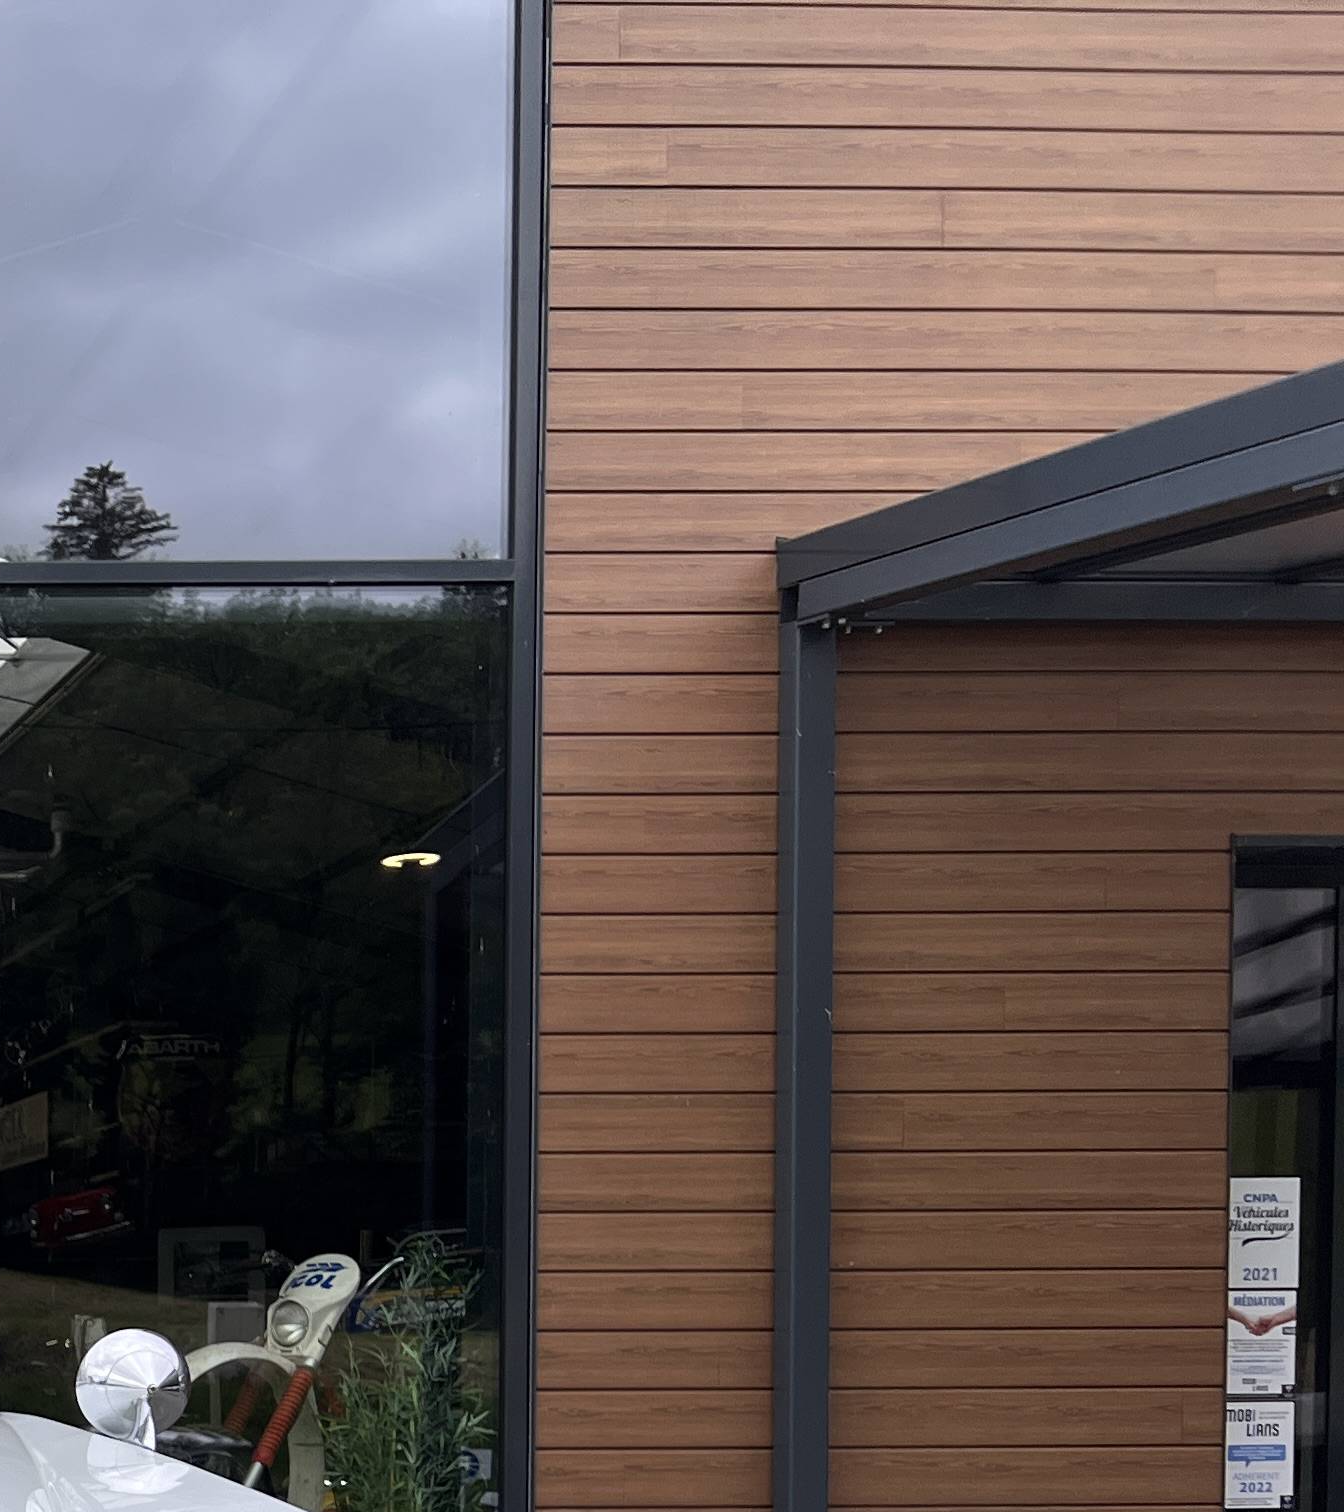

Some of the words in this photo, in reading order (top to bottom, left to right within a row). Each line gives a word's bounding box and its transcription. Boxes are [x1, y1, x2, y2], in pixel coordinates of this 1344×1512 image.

[127, 1039, 221, 1054] ABARTH
[1243, 1193, 1279, 1203] CNPA
[1228, 1219, 1295, 1235] Historiques
[1242, 1267, 1278, 1281] 2021
[1246, 1423, 1280, 1437] LIANS
[1239, 1481, 1273, 1493] 2022
